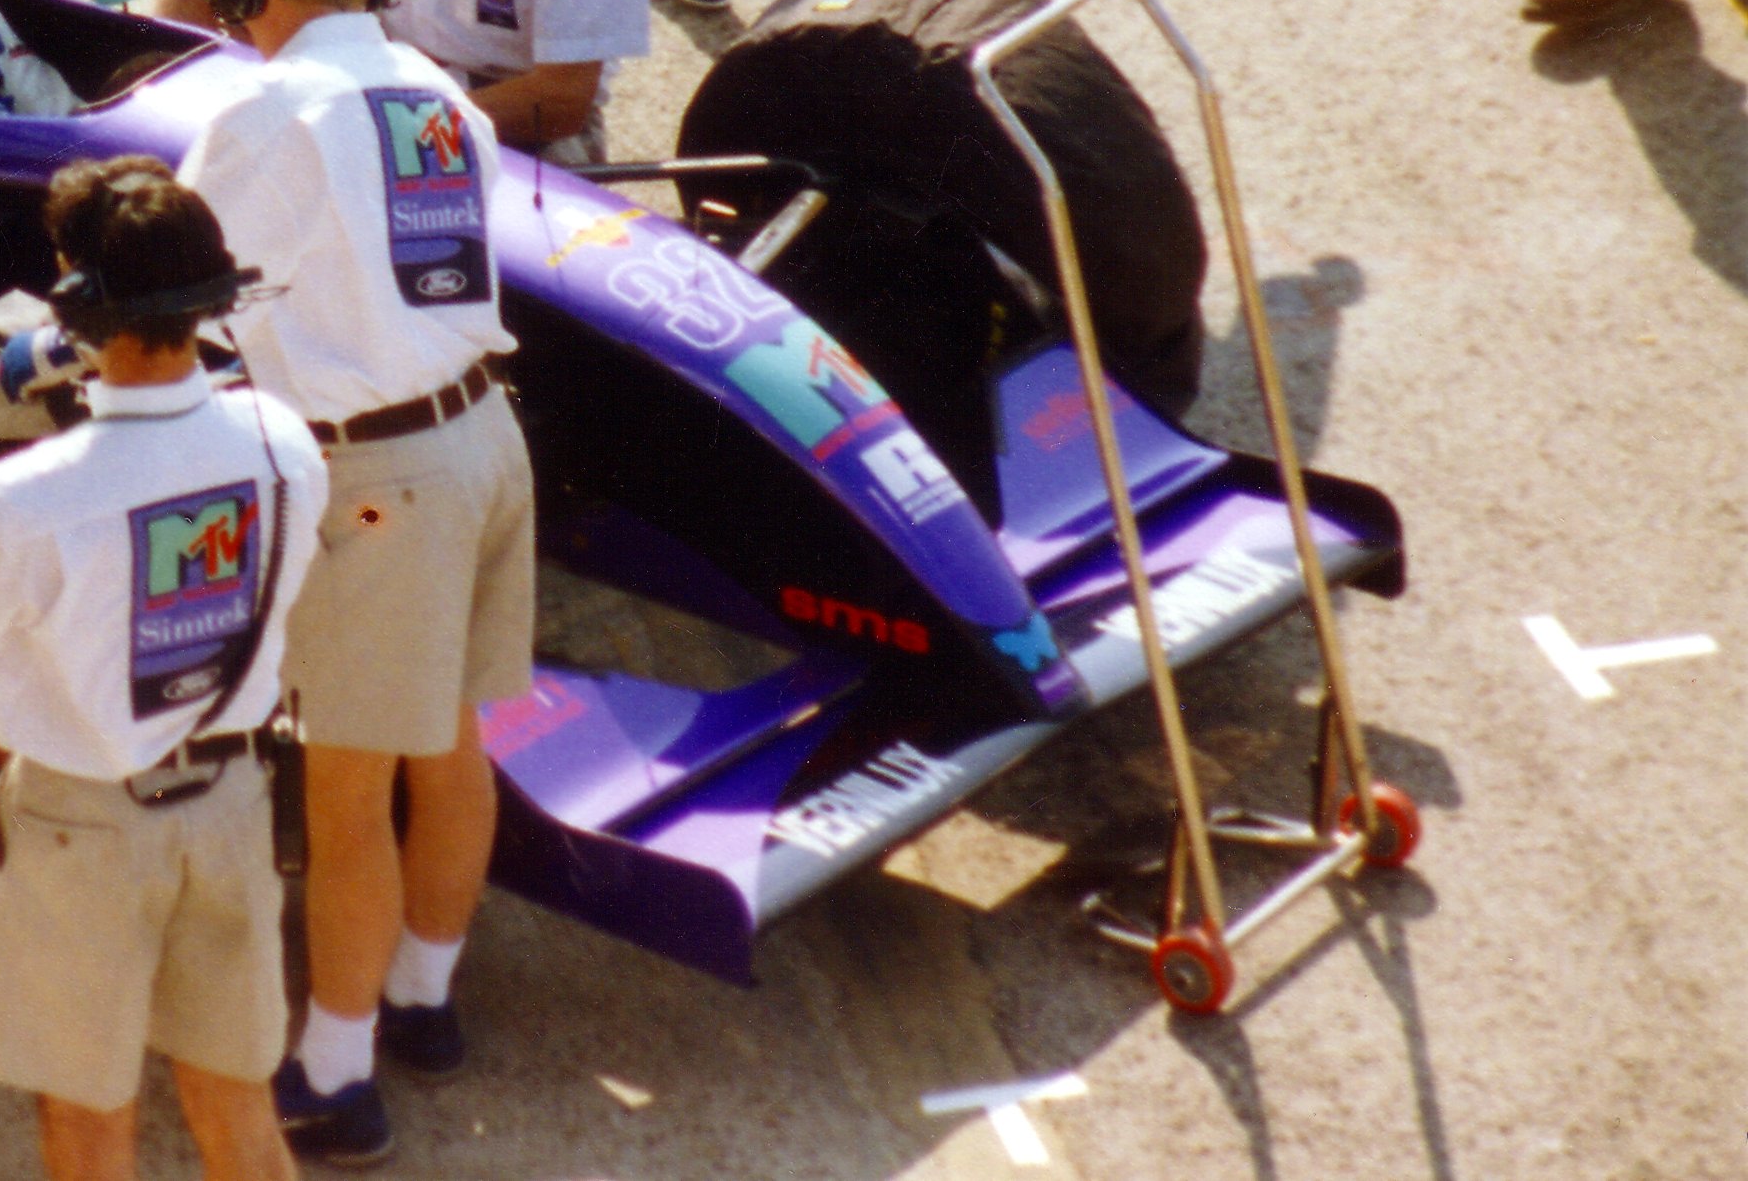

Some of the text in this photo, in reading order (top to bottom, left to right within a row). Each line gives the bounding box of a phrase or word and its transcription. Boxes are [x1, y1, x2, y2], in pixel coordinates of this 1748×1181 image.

[383, 99, 464, 178] MTV
[393, 196, 481, 232] Simtek
[607, 235, 795, 351] 32
[147, 498, 259, 597] MTV
[137, 597, 250, 650] Simtek
[781, 586, 930, 655] sms
